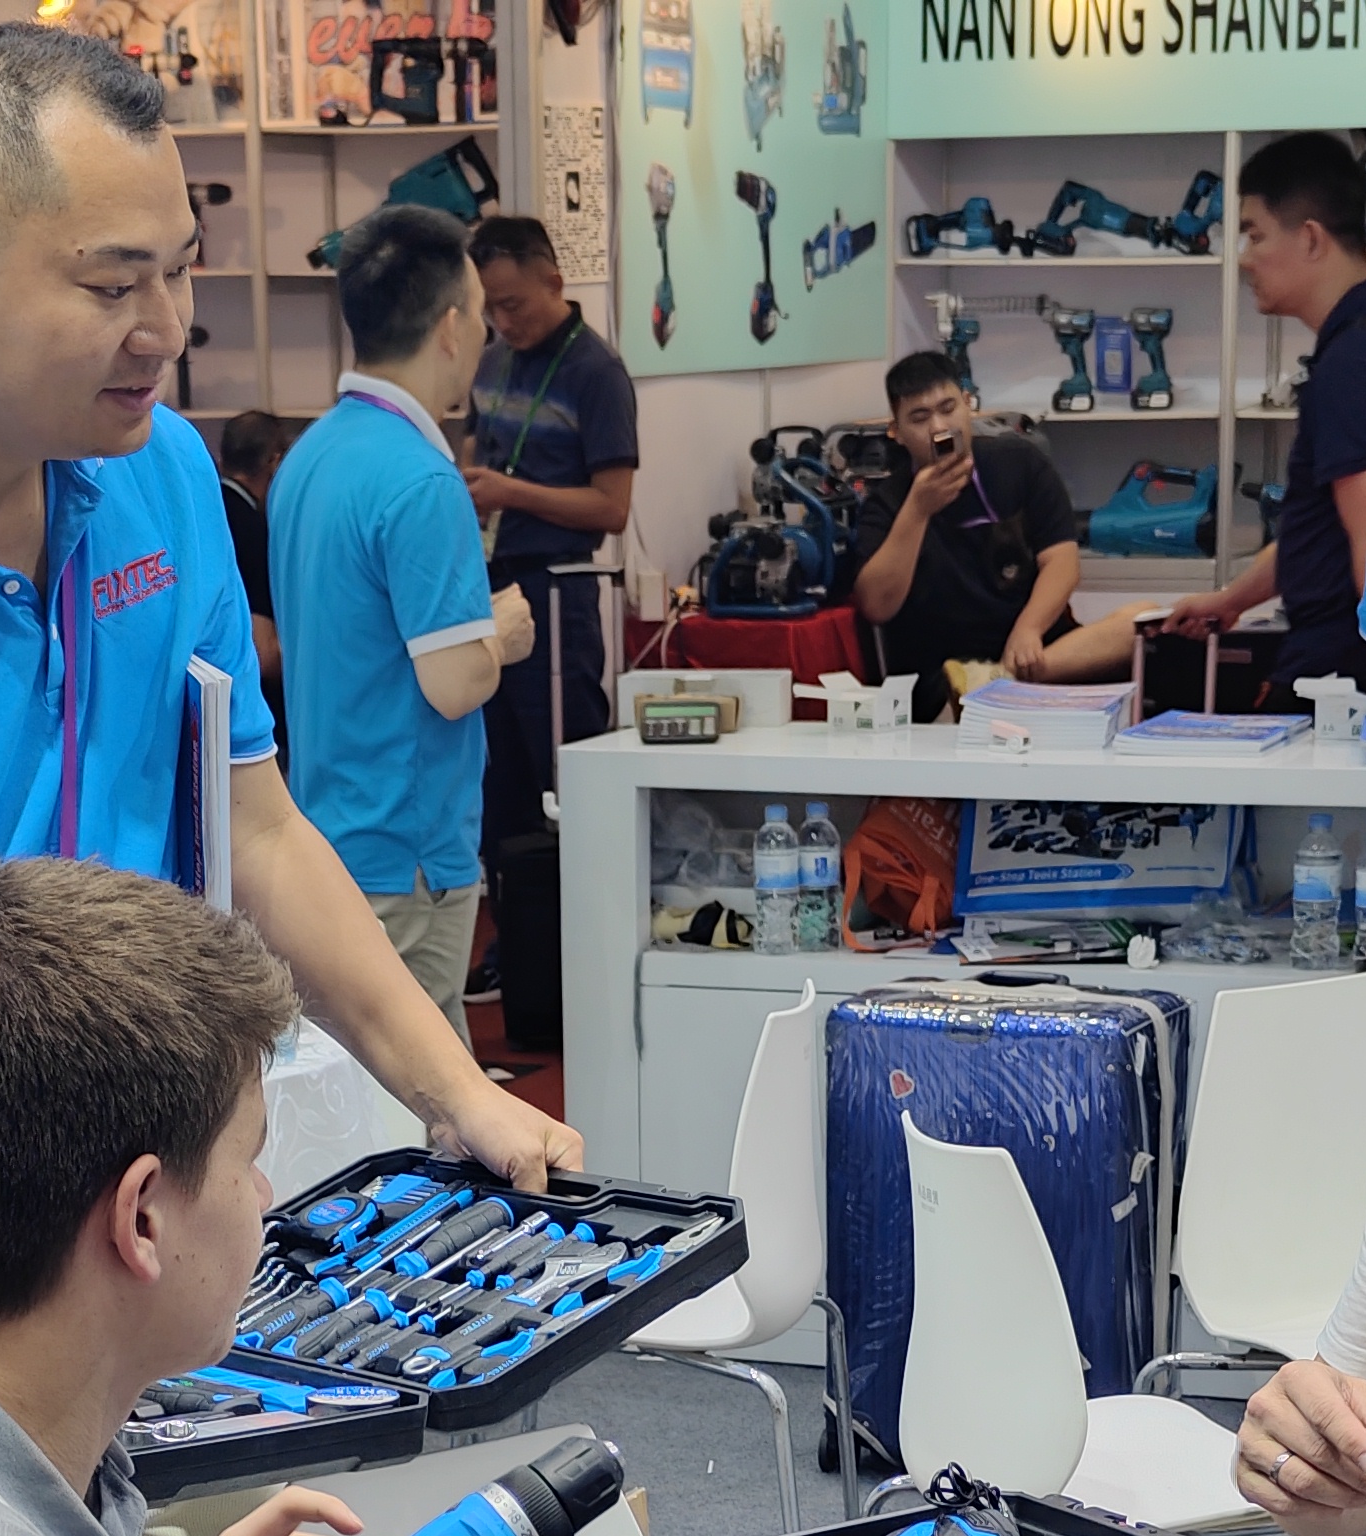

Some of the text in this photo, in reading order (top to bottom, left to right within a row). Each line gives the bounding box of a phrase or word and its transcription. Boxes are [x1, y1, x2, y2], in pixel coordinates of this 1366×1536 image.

[91, 549, 174, 611] FIXTEC
[1060, 866, 1102, 880] Station
[507, 1509, 522, 1525] 18
